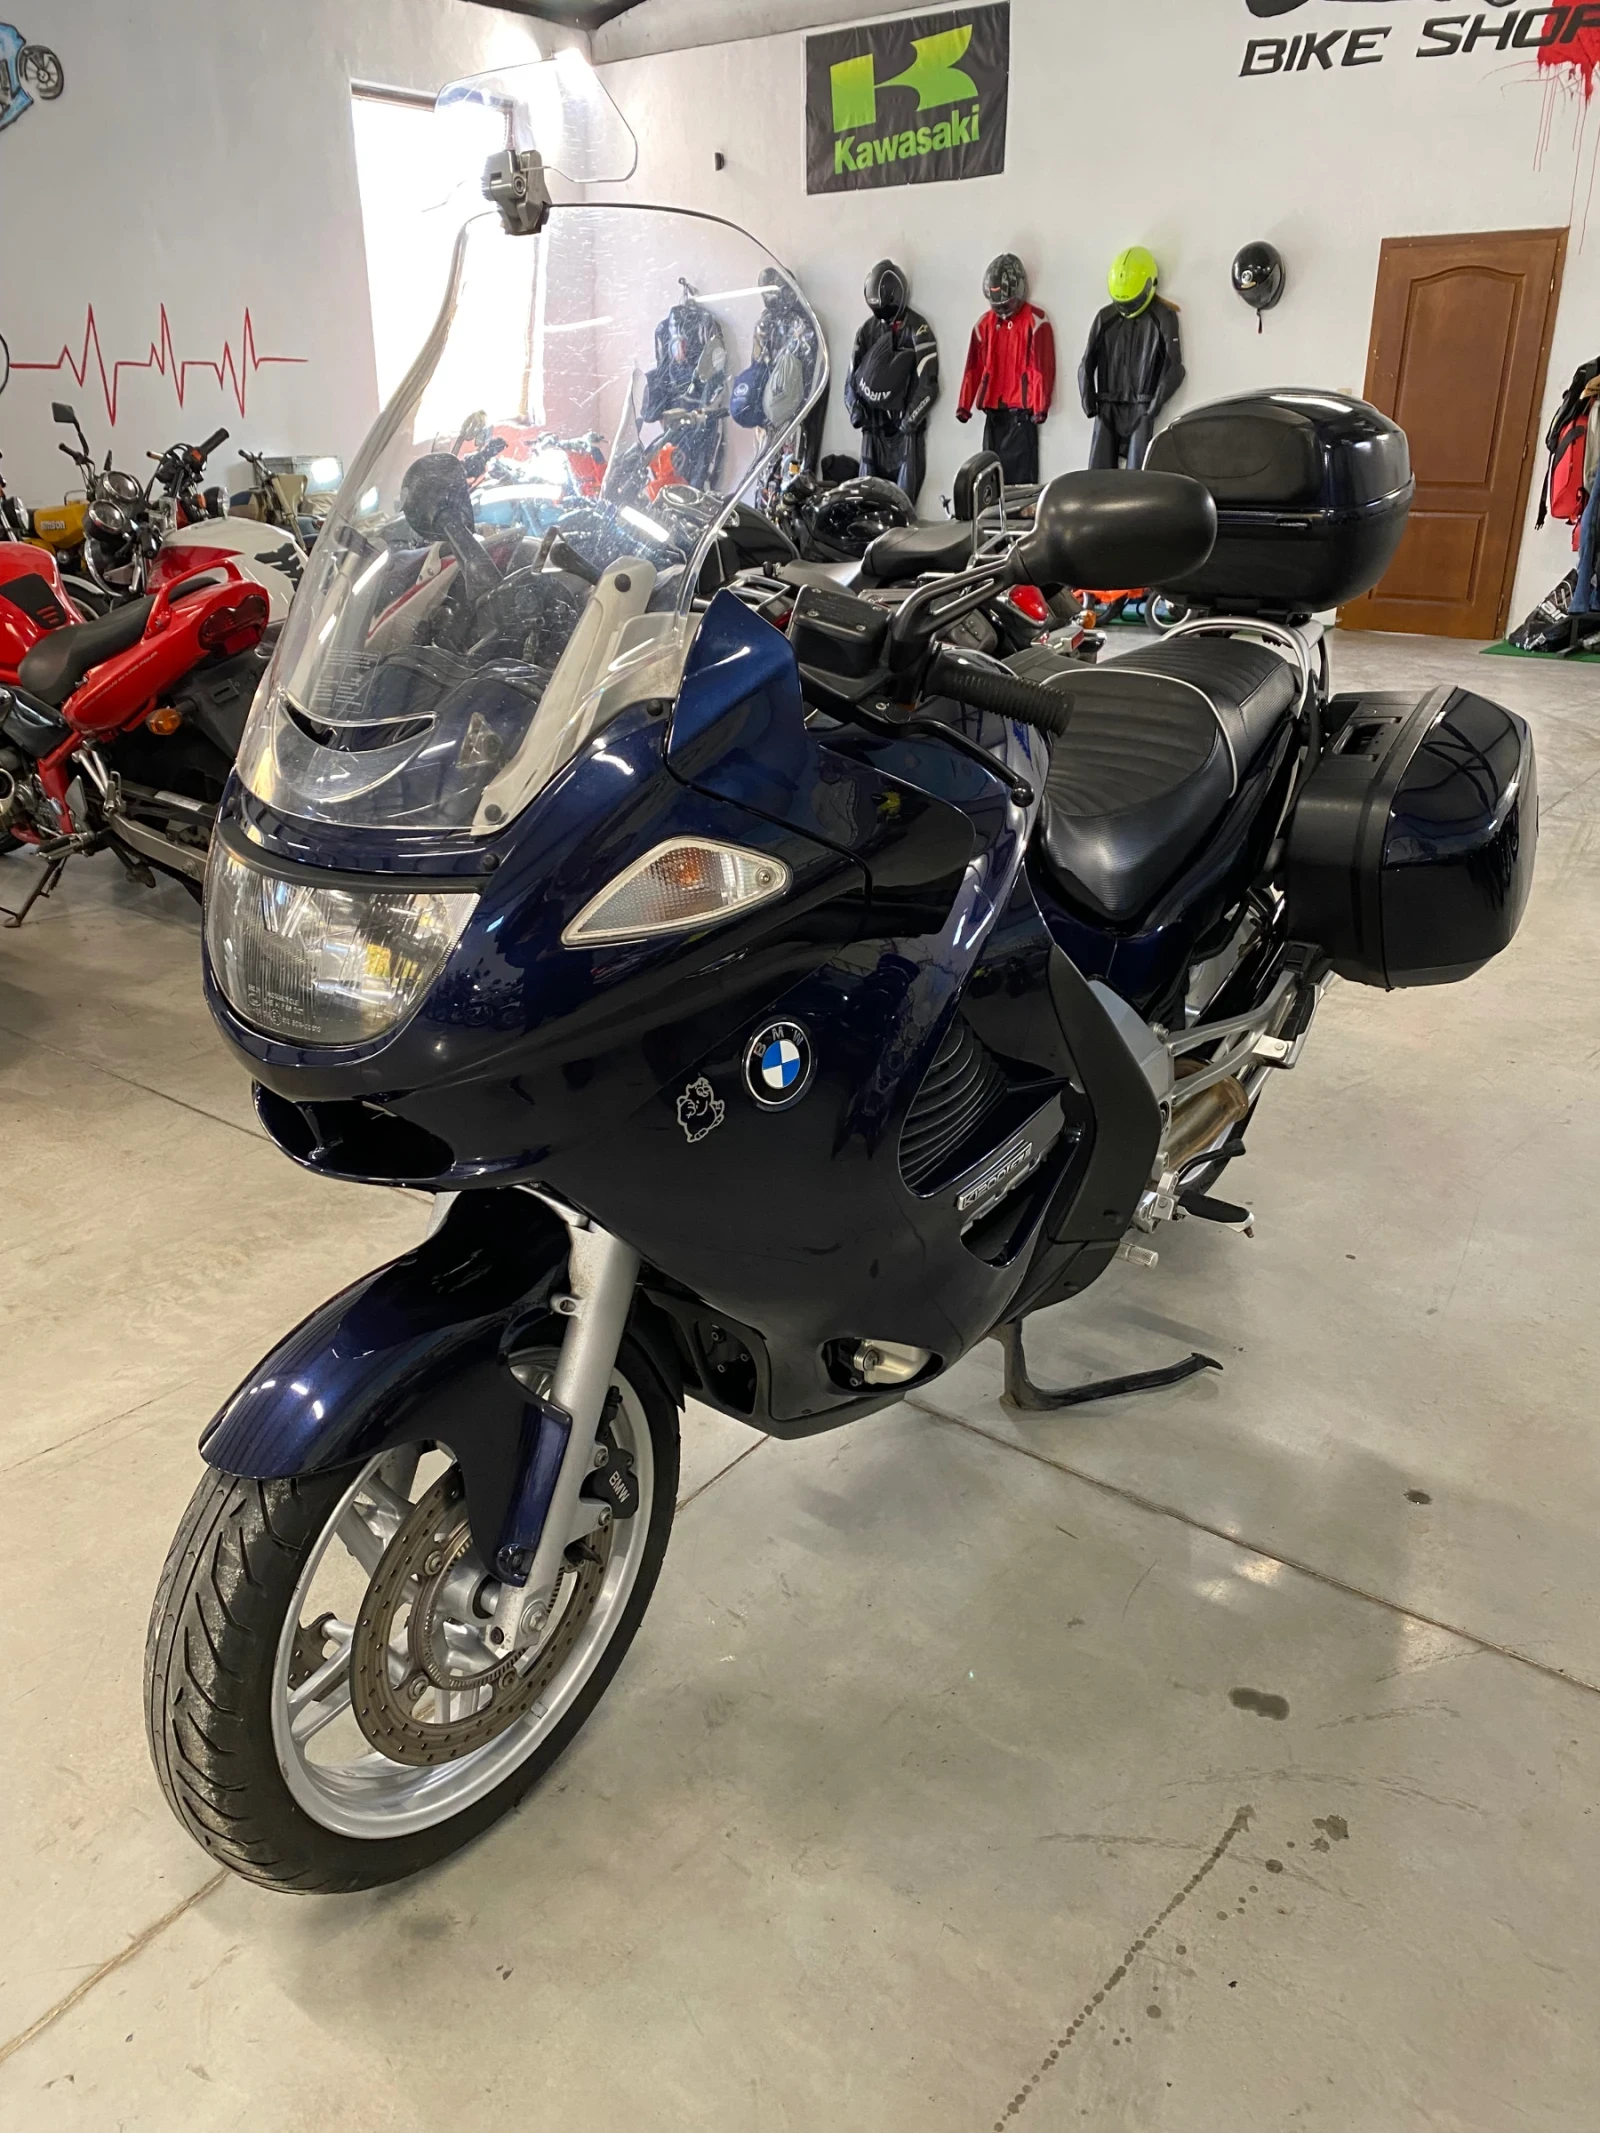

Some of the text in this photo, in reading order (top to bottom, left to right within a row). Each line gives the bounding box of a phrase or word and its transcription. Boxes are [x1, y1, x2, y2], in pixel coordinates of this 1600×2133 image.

[1238, 26, 1393, 77] BIKE
[834, 103, 980, 175] Kawasaki
[753, 1025, 804, 1058] BMW
[608, 1470, 631, 1503] BMW
